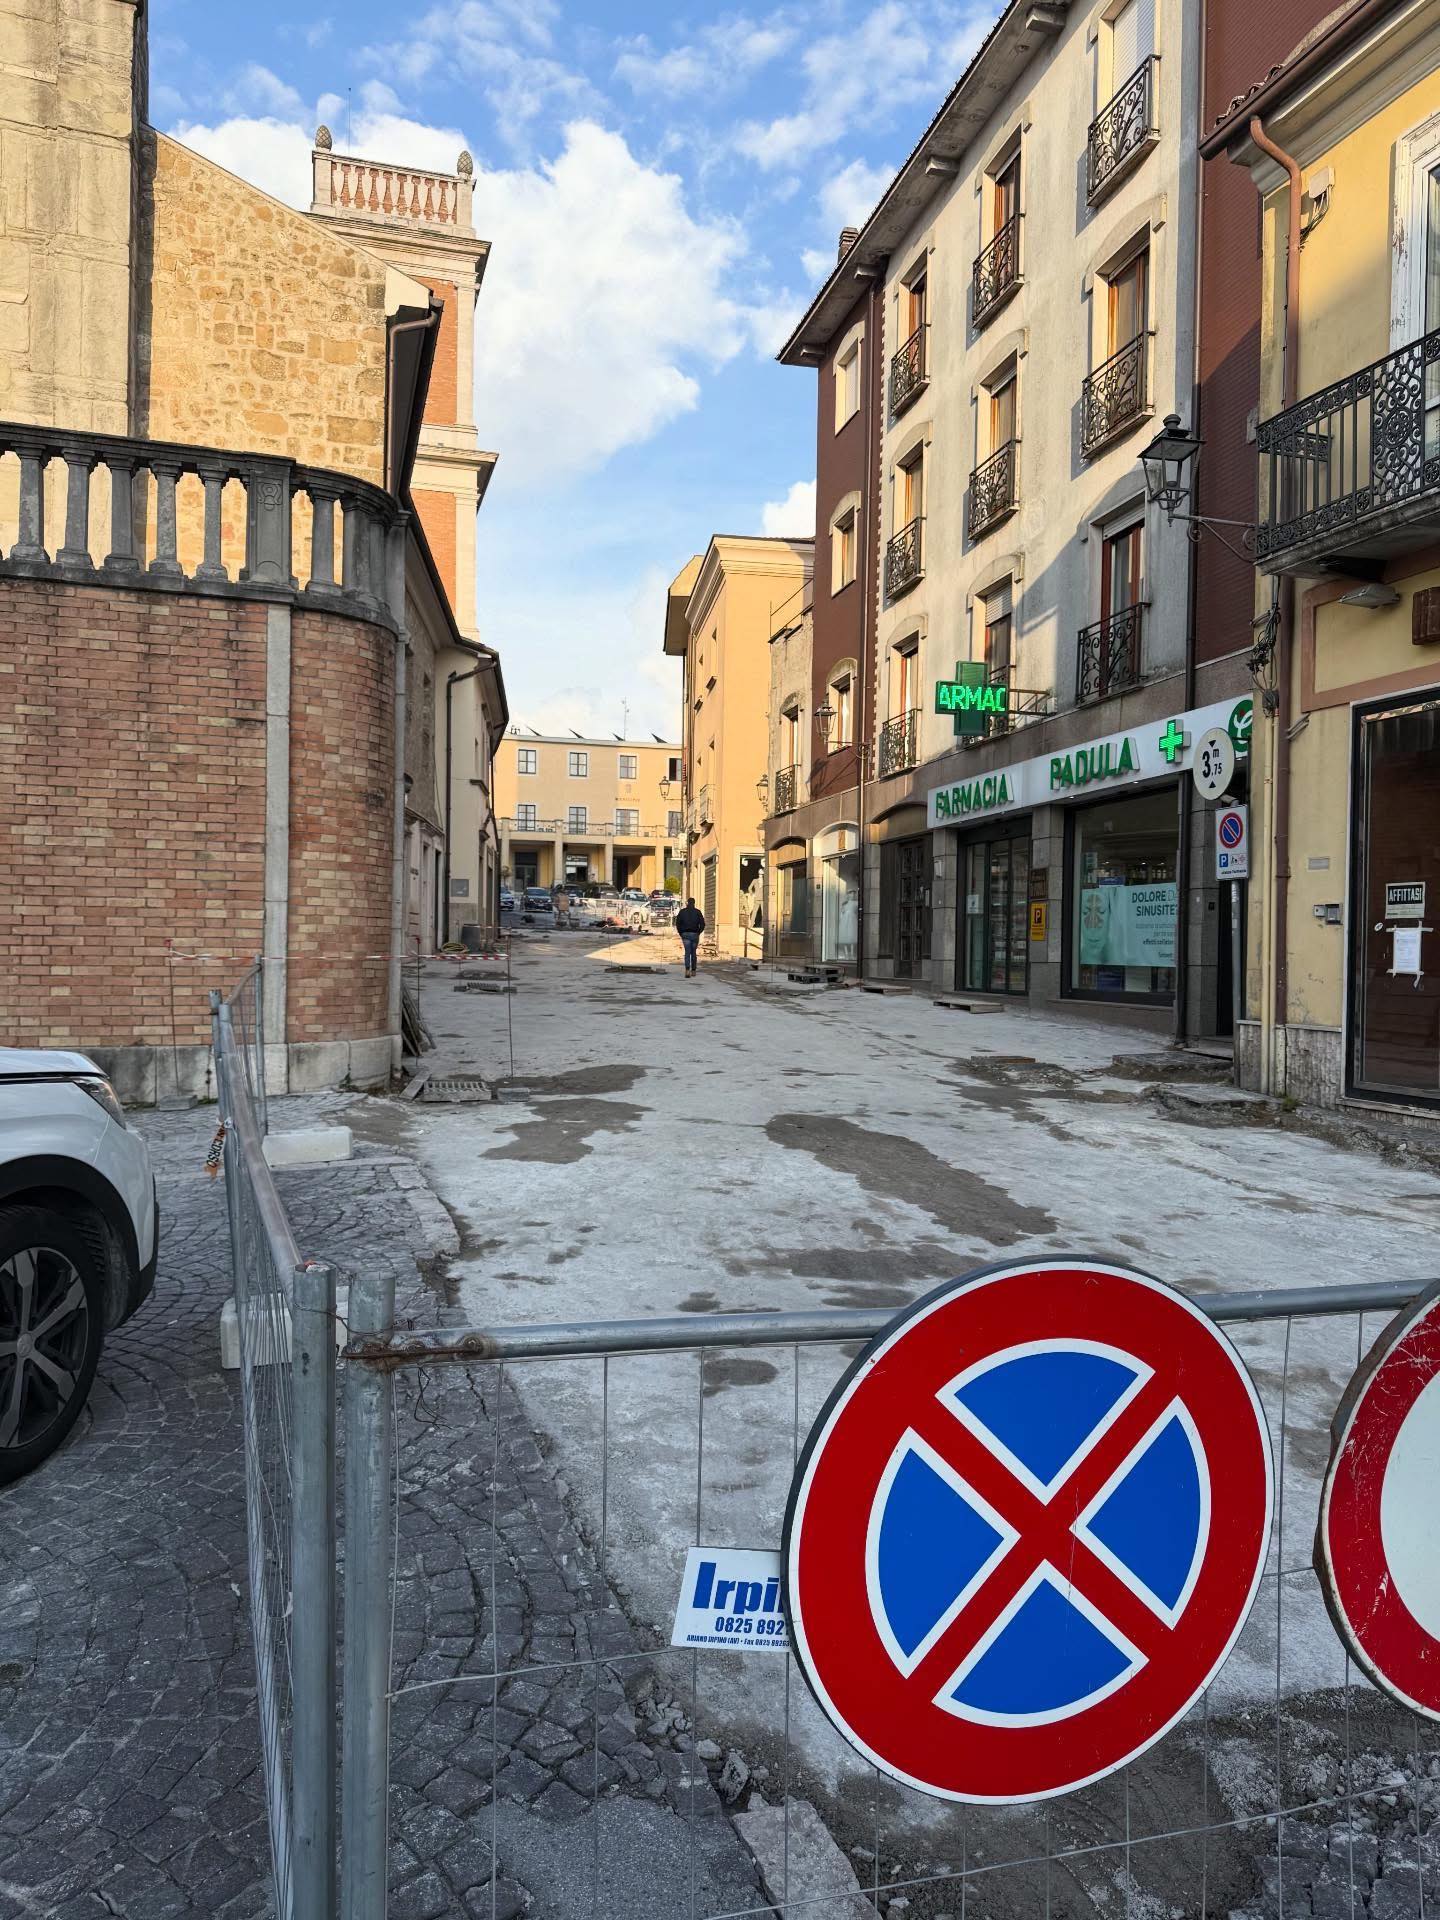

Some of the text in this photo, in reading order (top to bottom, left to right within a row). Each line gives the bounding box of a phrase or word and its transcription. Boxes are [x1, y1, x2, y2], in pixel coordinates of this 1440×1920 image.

[935, 737, 1139, 819] FARMACIA PADULA
[1132, 891, 1166, 903] DOLORE
[1389, 888, 1422, 901] AFFITTASI
[206, 1138, 224, 1168] CORSO
[693, 1562, 784, 1614] Irpi
[715, 1616, 789, 1635] 0825 892
[727, 1637, 740, 1645] (AV)
[743, 1638, 754, 1646] Fax
